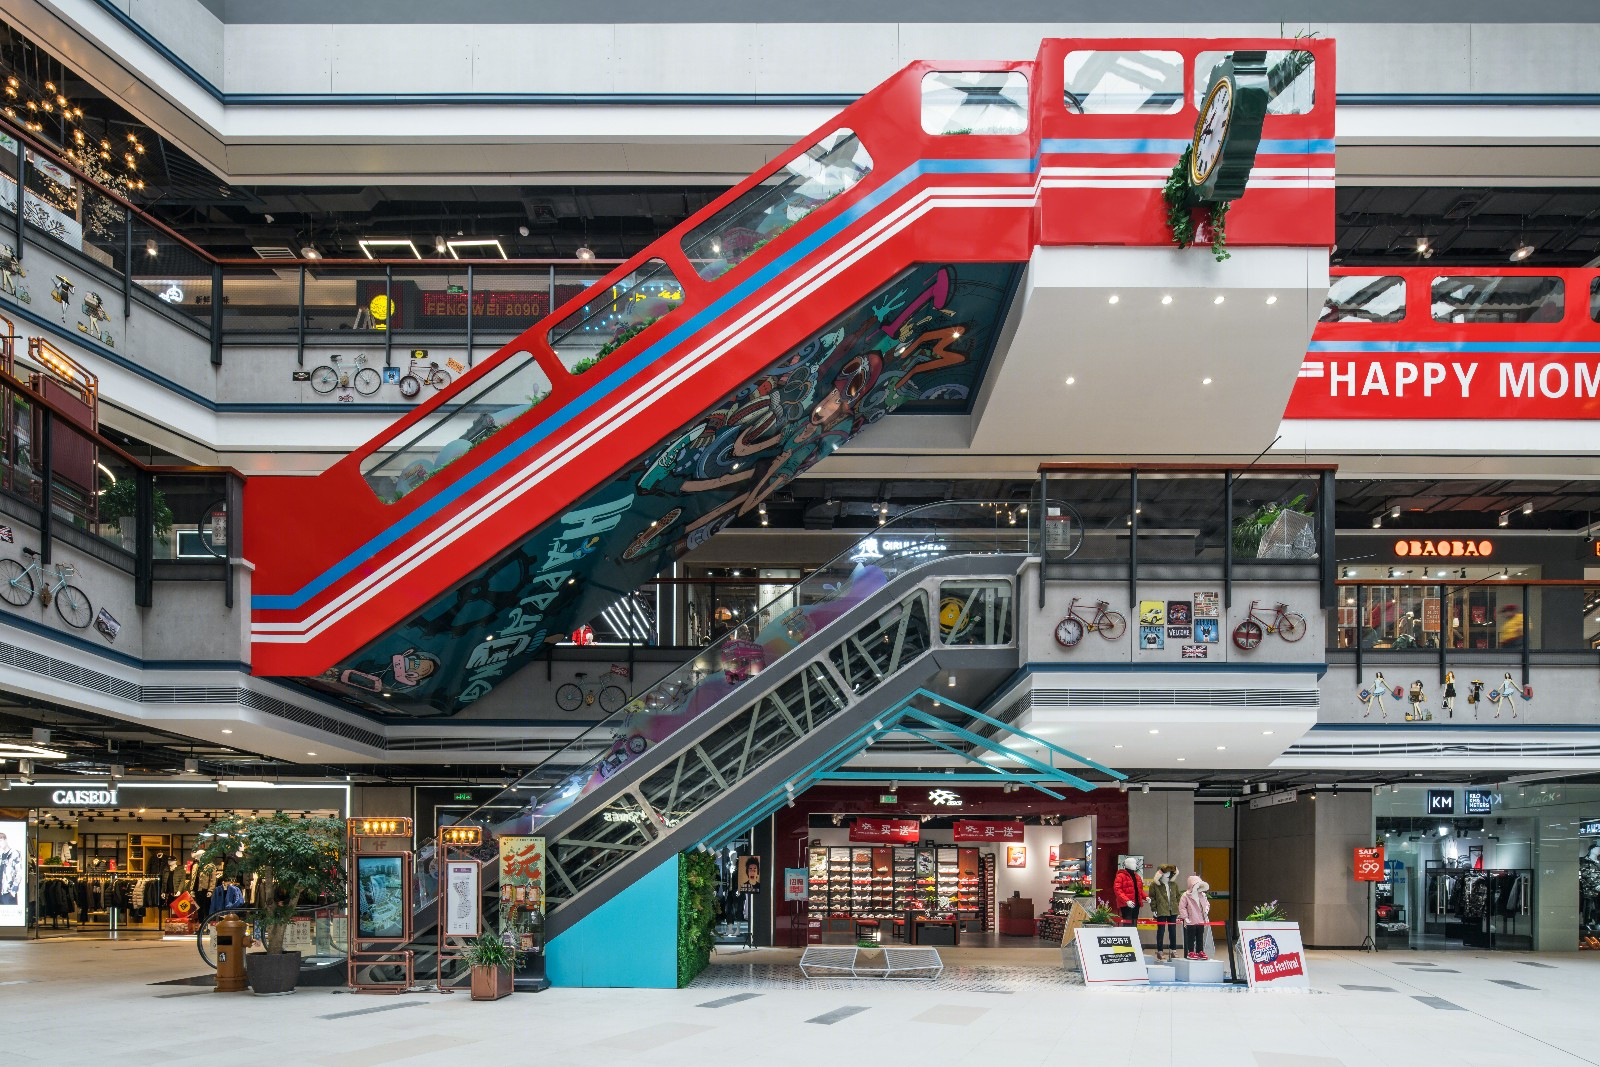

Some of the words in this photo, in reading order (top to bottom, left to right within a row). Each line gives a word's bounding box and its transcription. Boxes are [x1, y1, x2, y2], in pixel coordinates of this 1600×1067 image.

[428, 303, 467, 316] FENG
[472, 303, 500, 316] WEI
[505, 303, 540, 316] 8090
[1330, 362, 1479, 398] HAPPY
[1499, 362, 1600, 399] MOM
[1394, 540, 1493, 557] OBAOBAO
[52, 790, 118, 805] CAISEDI
[1432, 796, 1452, 808] KM
[881, 824, 919, 836] 买一送一
[984, 826, 1023, 837] 买一送一
